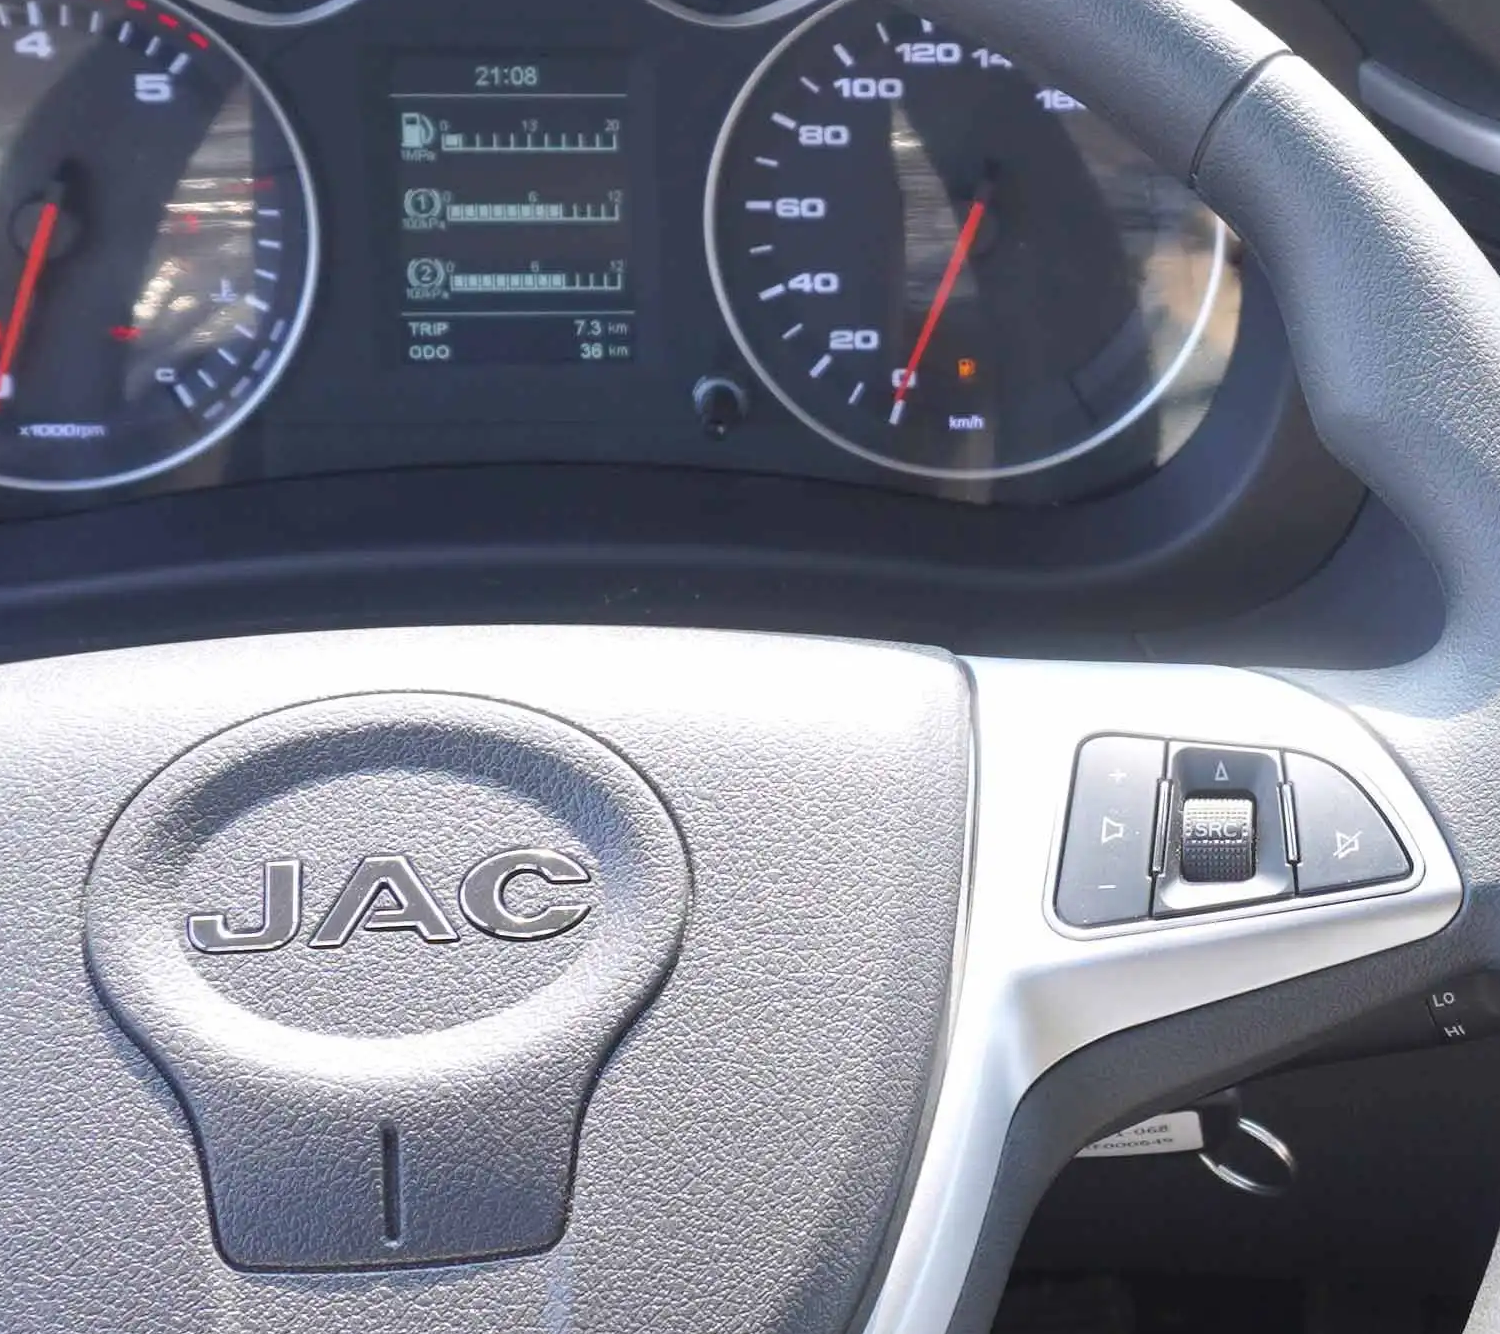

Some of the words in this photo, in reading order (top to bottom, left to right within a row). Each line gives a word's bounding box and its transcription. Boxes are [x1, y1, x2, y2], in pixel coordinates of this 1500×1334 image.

[15, 33, 51, 58] 4
[895, 42, 962, 64] 120
[475, 66, 538, 86] 21:08
[135, 74, 171, 102] 5
[833, 77, 903, 99] 100
[798, 124, 849, 145] 80
[775, 197, 825, 219] 60
[787, 271, 839, 294] 40
[408, 321, 449, 336] TRIP
[608, 322, 628, 335] km
[829, 329, 879, 350] 20
[409, 344, 450, 360] ODO
[608, 344, 628, 357] km
[948, 414, 985, 432] km/h
[1194, 821, 1239, 838] SRC
[185, 847, 593, 955] JAC
[1432, 989, 1456, 1009] LO
[1443, 1022, 1466, 1040] HI
